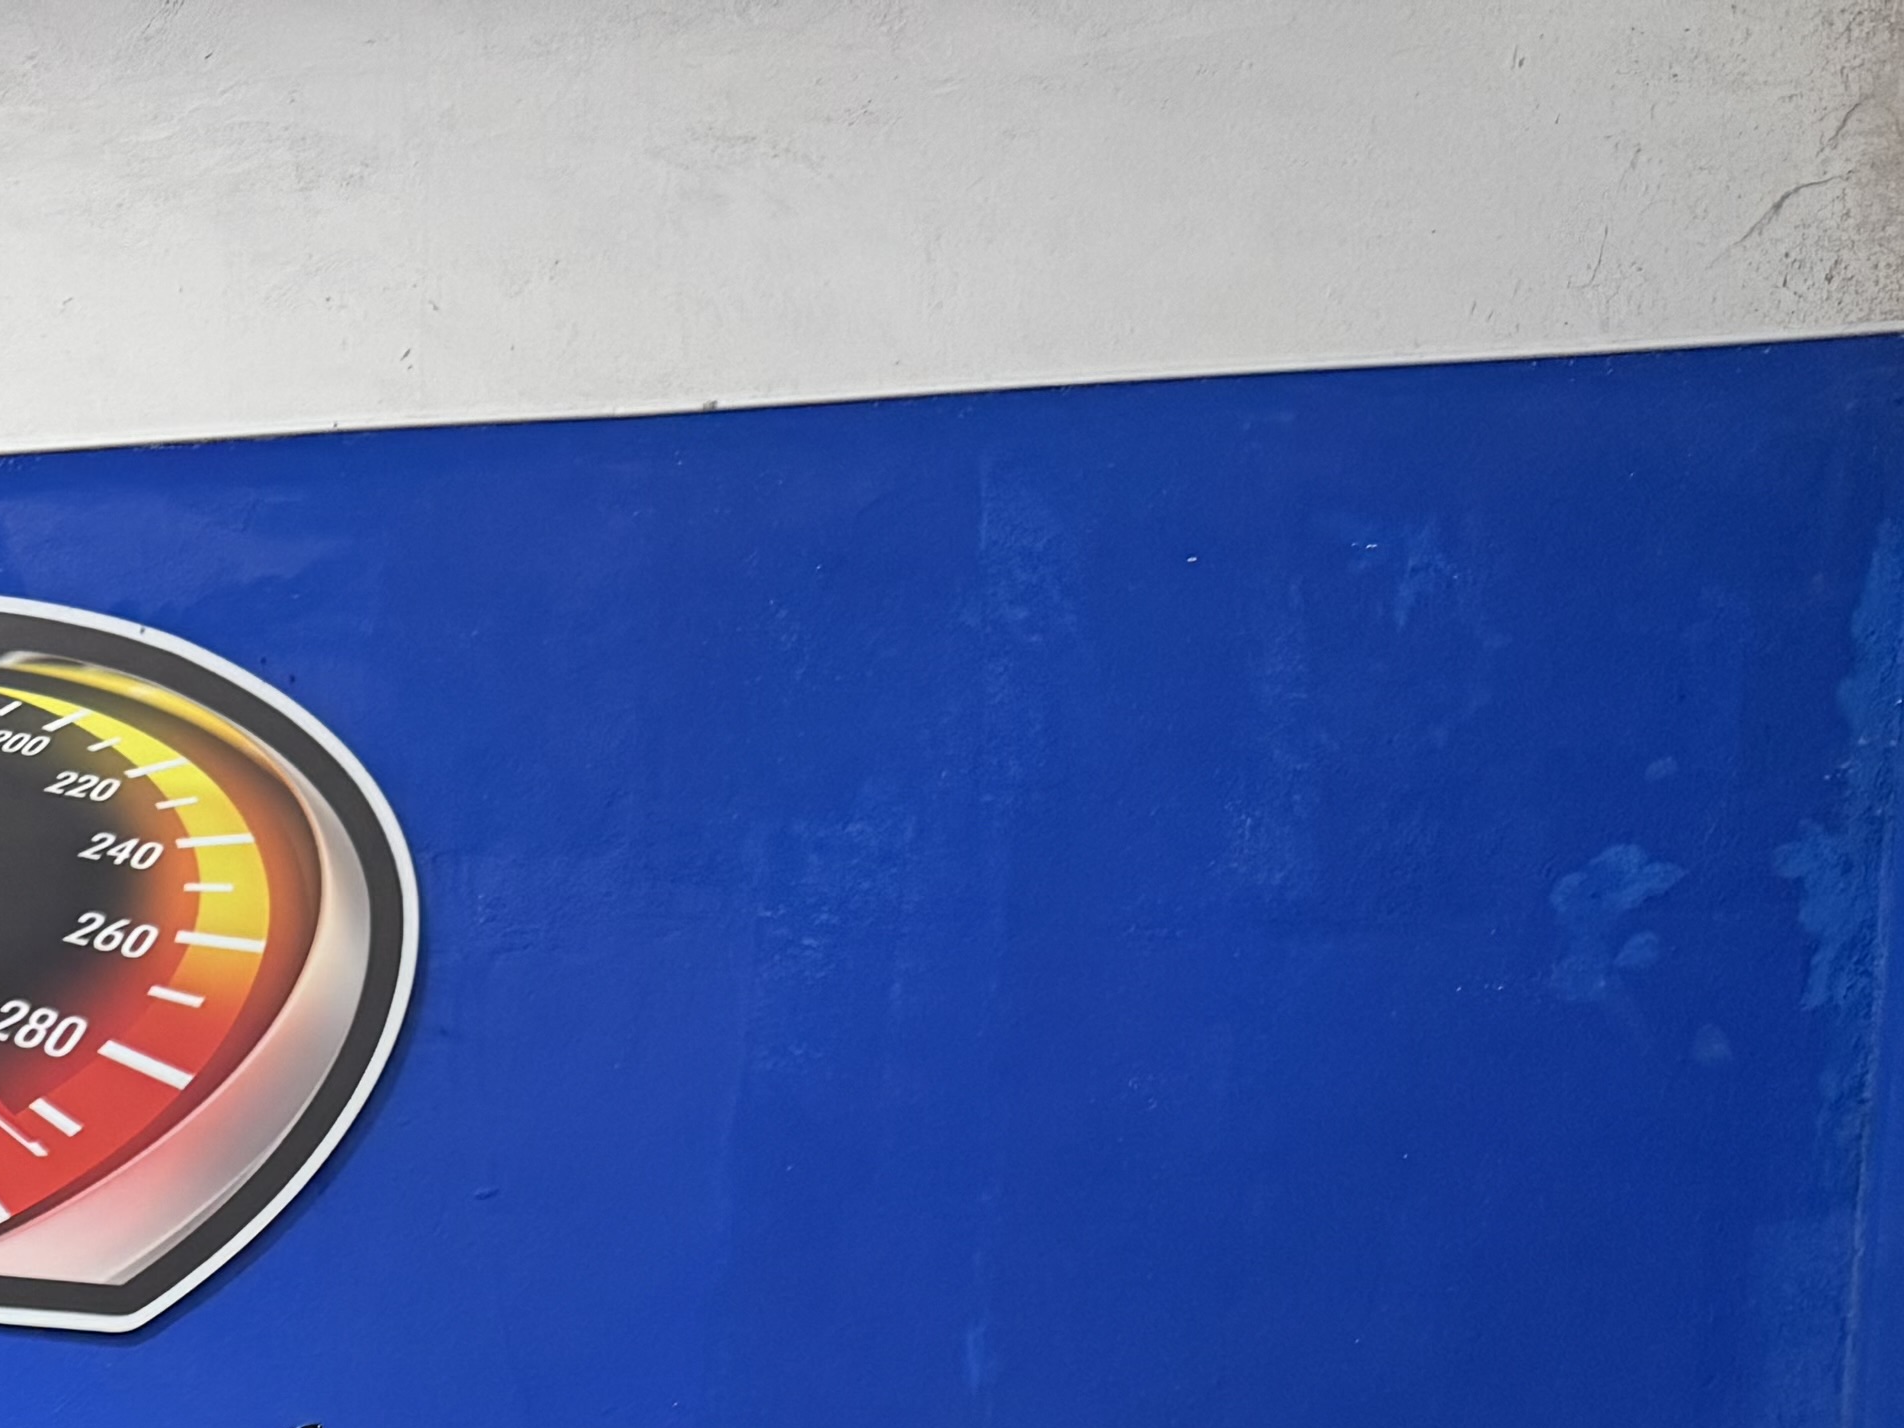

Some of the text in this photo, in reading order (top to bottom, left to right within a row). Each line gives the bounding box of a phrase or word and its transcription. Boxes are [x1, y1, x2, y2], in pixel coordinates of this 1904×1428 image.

[44, 771, 121, 802] 220
[78, 831, 164, 870] 240
[62, 911, 159, 959] 260
